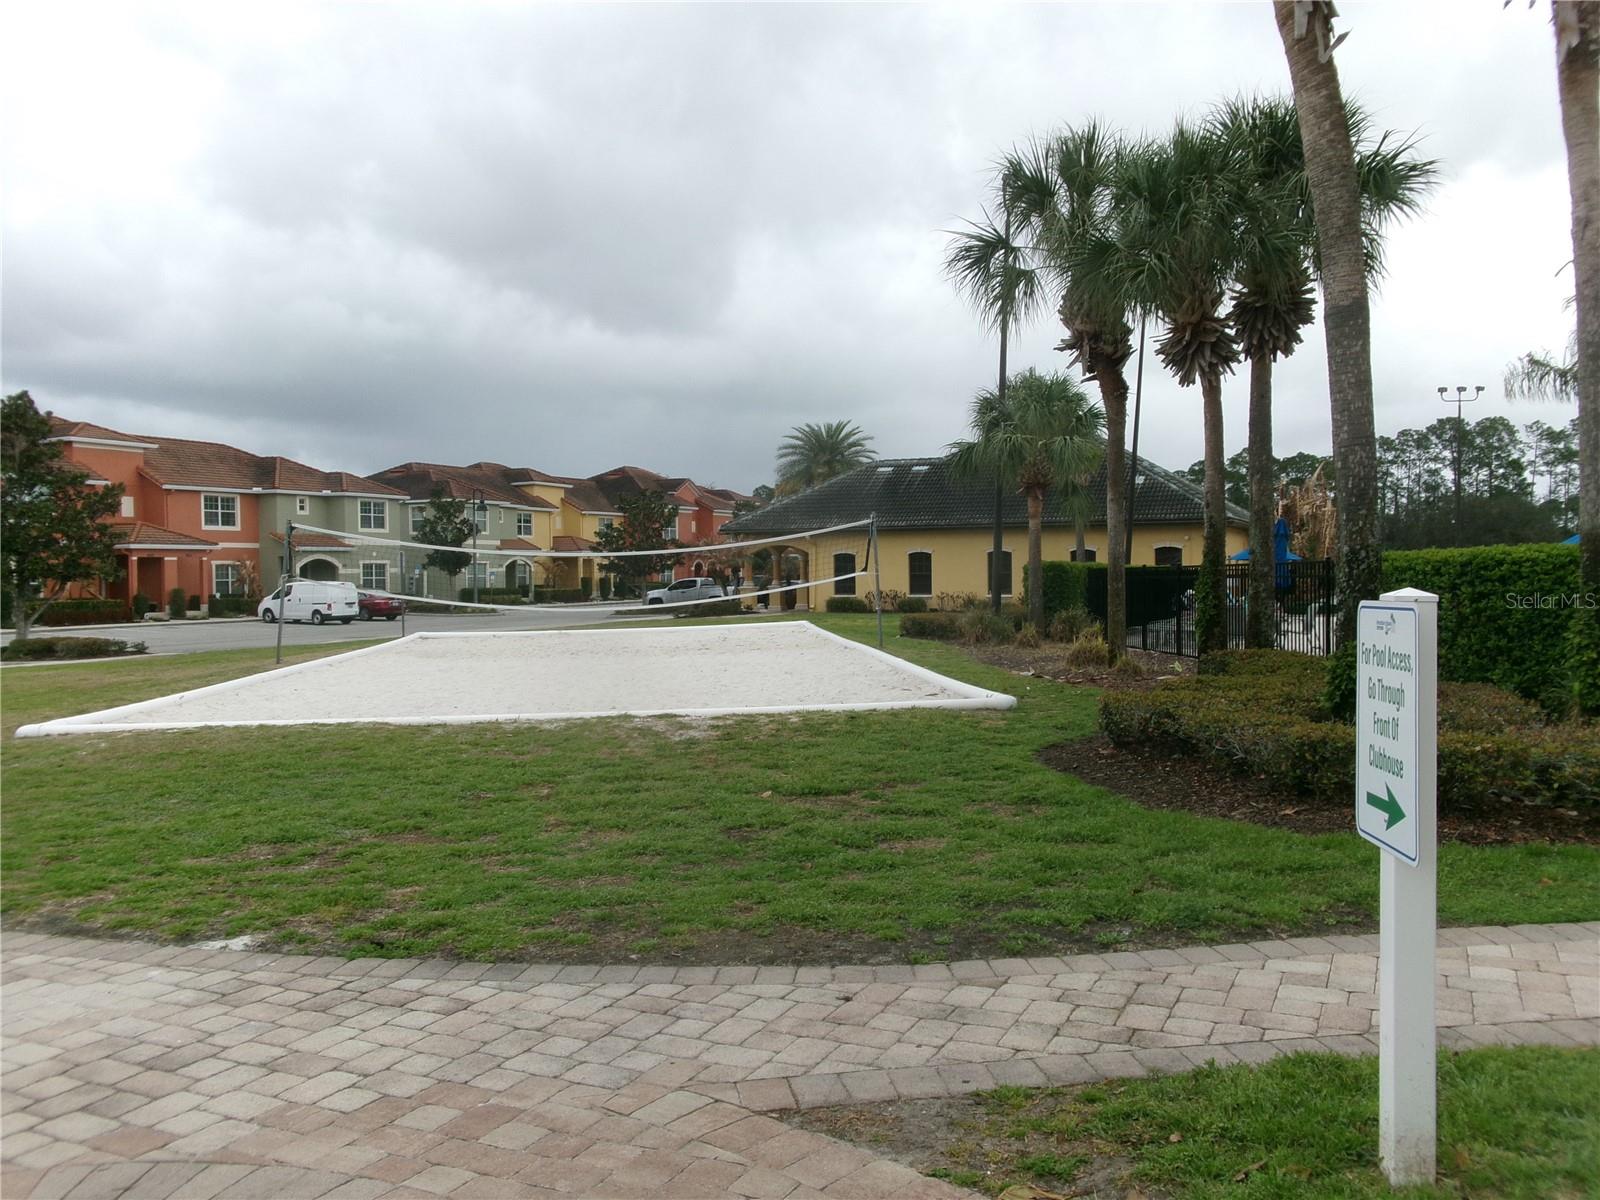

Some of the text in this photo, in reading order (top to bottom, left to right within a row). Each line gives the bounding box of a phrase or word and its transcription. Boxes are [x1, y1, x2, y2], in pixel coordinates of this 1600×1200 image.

[1361, 642, 1413, 677] For Pool Access,
[1368, 676, 1405, 712] Go Through
[1373, 711, 1400, 741] Front Of
[1369, 743, 1404, 779] Clubhouse
